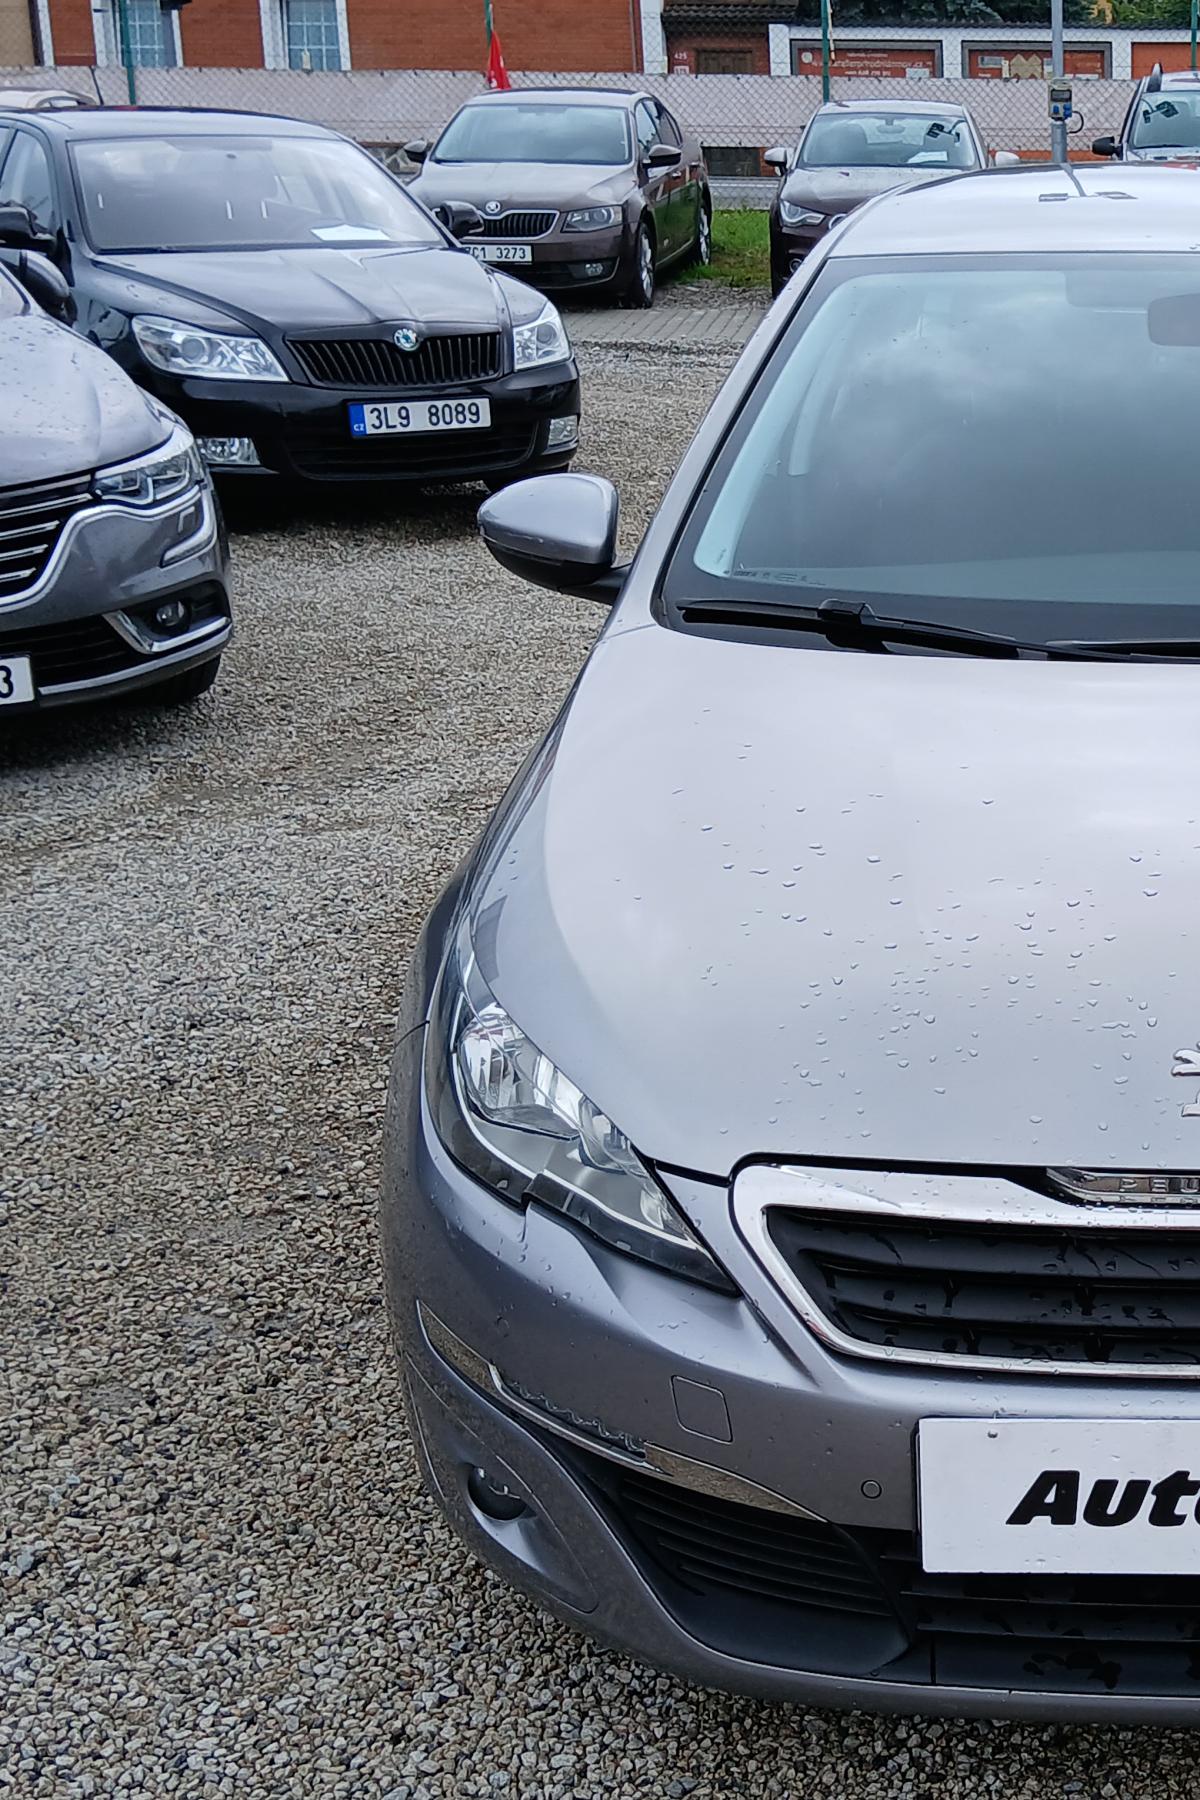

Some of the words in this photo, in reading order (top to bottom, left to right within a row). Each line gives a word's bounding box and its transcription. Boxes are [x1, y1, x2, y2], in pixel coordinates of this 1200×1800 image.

[496, 247, 526, 259] 3273
[353, 423, 364, 431] CZ
[370, 406, 410, 430] 3L9
[427, 402, 480, 426] 8089
